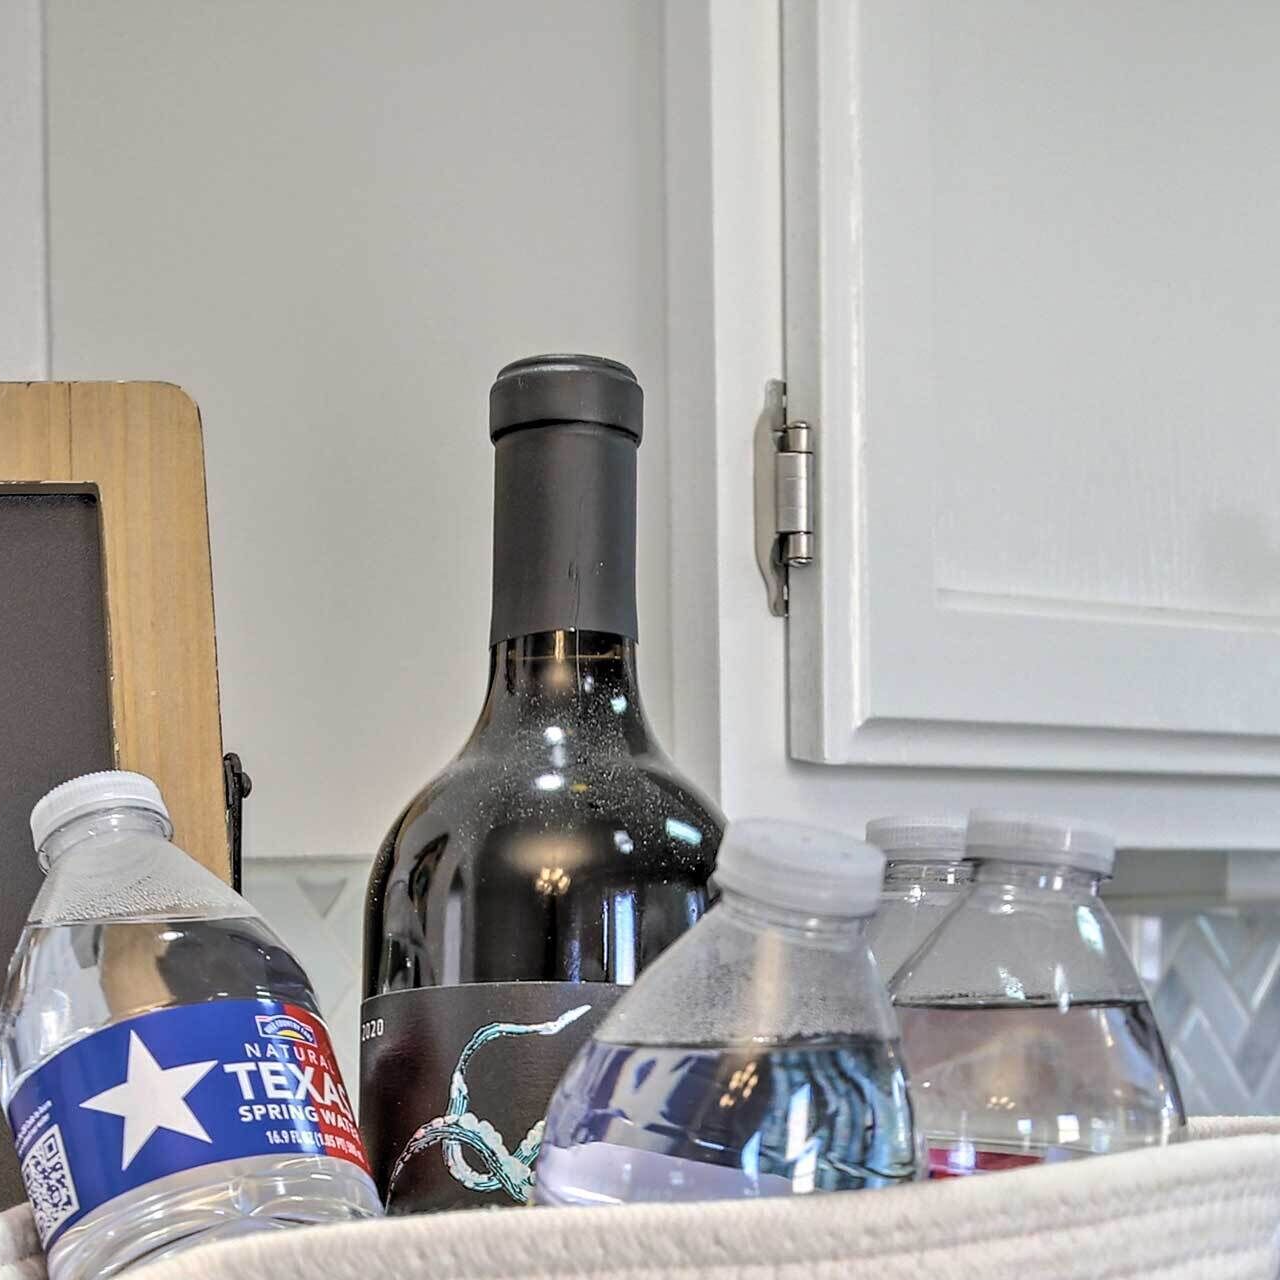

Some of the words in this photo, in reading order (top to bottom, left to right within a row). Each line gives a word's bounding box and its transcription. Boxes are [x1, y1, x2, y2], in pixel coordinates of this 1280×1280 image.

[361, 1018, 384, 1041] 2020
[244, 1043, 335, 1074] NATURAL
[223, 1061, 354, 1122] TEXAS
[238, 1103, 319, 1122] SPRING
[265, 1130, 290, 1145] 16.9
